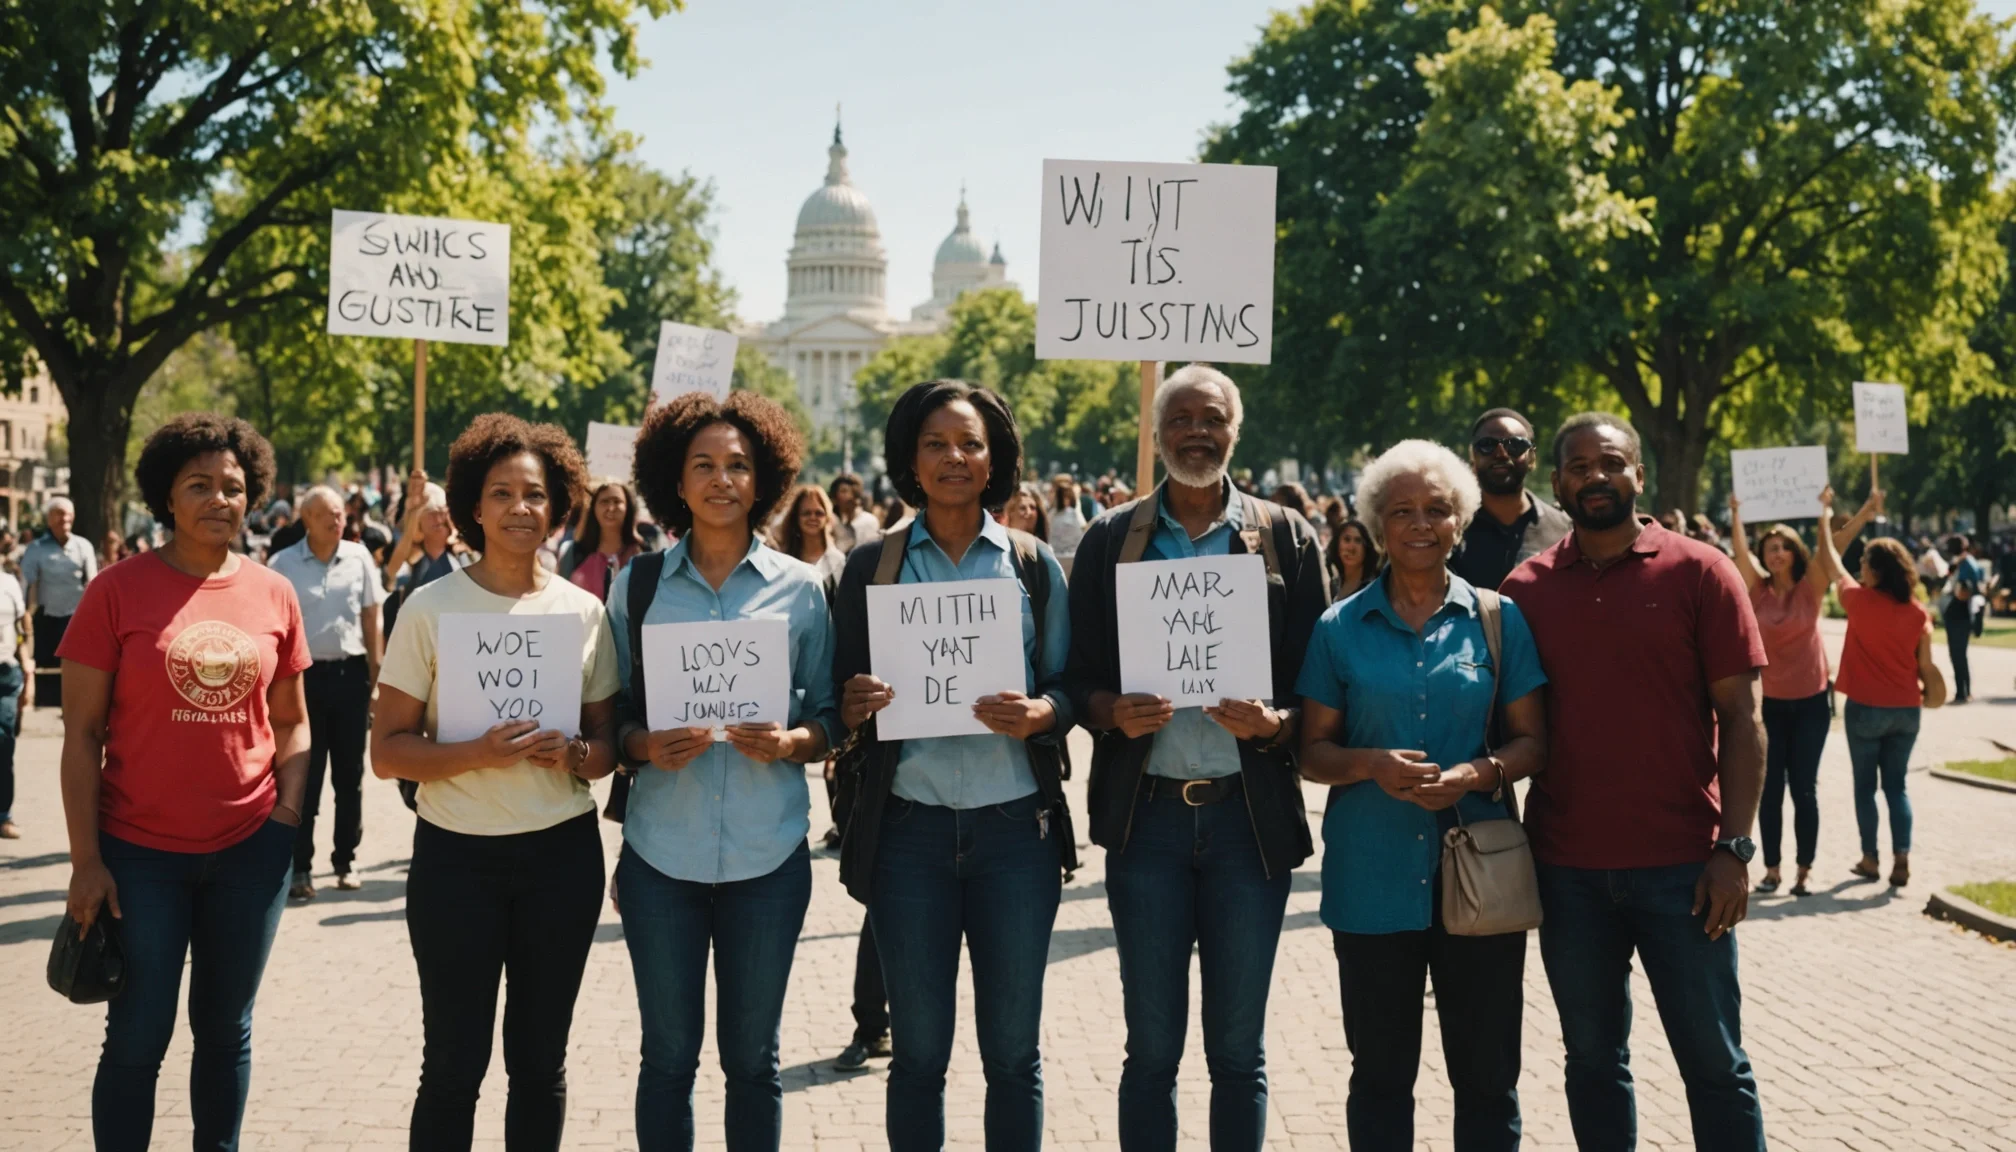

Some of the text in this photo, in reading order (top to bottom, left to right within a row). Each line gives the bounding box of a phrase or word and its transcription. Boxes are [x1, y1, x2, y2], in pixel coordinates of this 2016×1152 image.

[1151, 571, 1234, 600] MAR
[901, 593, 996, 625] MITTH
[476, 630, 542, 658] WOE
[925, 675, 962, 705] DE
